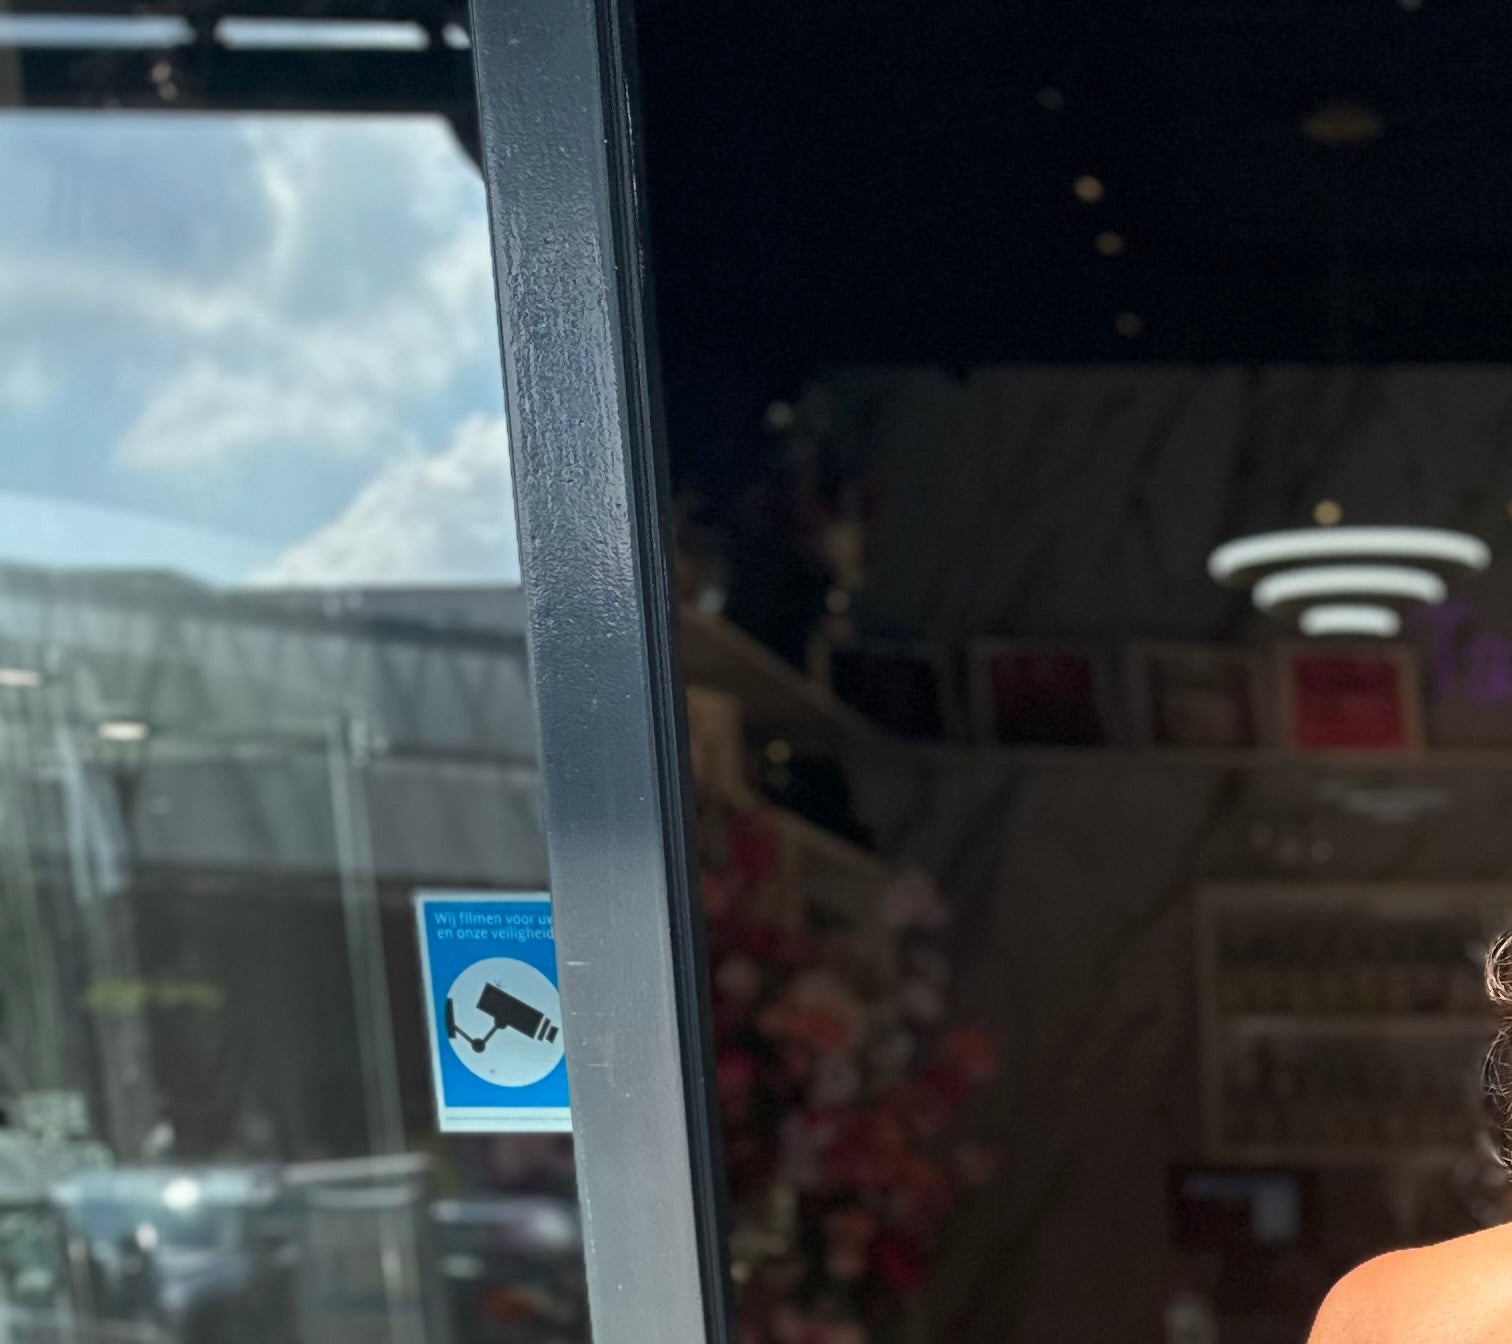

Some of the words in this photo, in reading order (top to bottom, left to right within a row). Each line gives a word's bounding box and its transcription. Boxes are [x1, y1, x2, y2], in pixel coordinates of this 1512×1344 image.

[434, 911, 456, 928] Wij
[459, 911, 502, 925] filmen
[505, 914, 533, 925] voor
[437, 928, 453, 939] en
[456, 928, 489, 939] onze
[491, 925, 554, 943] veiligheid
